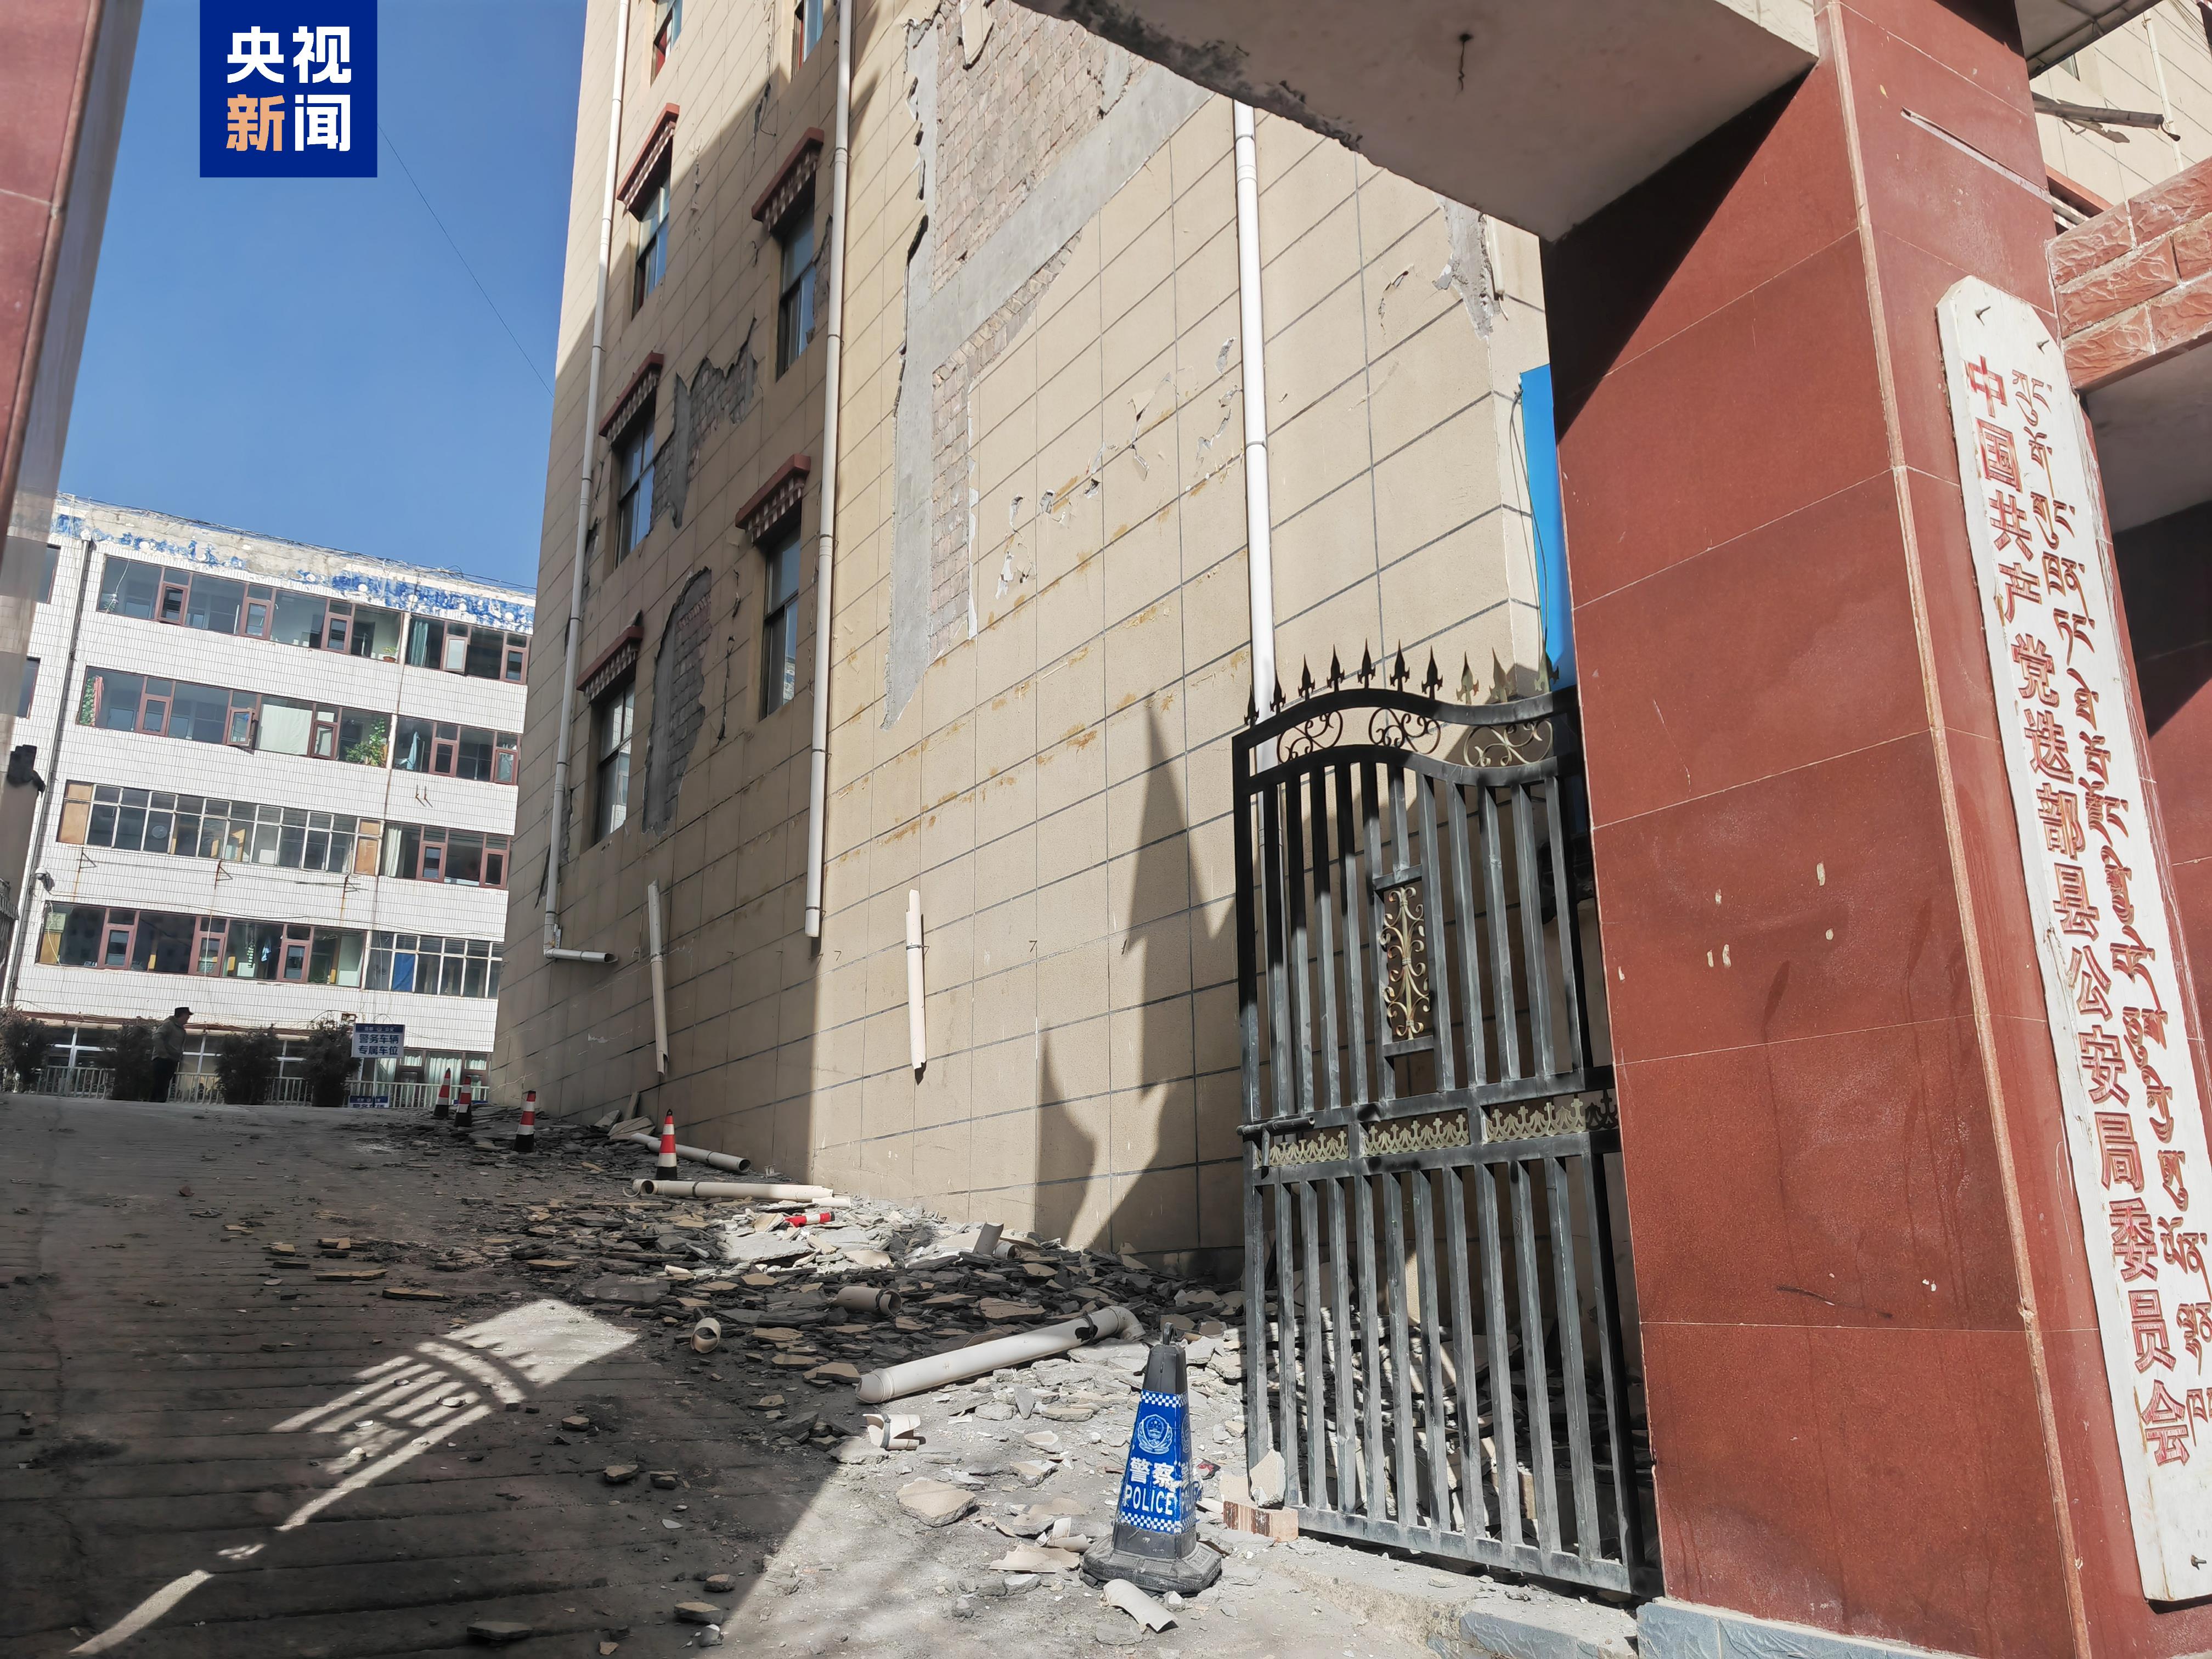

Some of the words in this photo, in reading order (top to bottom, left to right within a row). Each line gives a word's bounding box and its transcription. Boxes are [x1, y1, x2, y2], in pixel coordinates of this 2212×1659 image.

[1966, 355, 2190, 1467] 中国共产党迭部县公安局委员会
[358, 1045, 399, 1055] 专属车位
[359, 1034, 400, 1044] 警务车辆
[1130, 1457, 1177, 1492] 警察
[1123, 1484, 1173, 1516] POLICE
